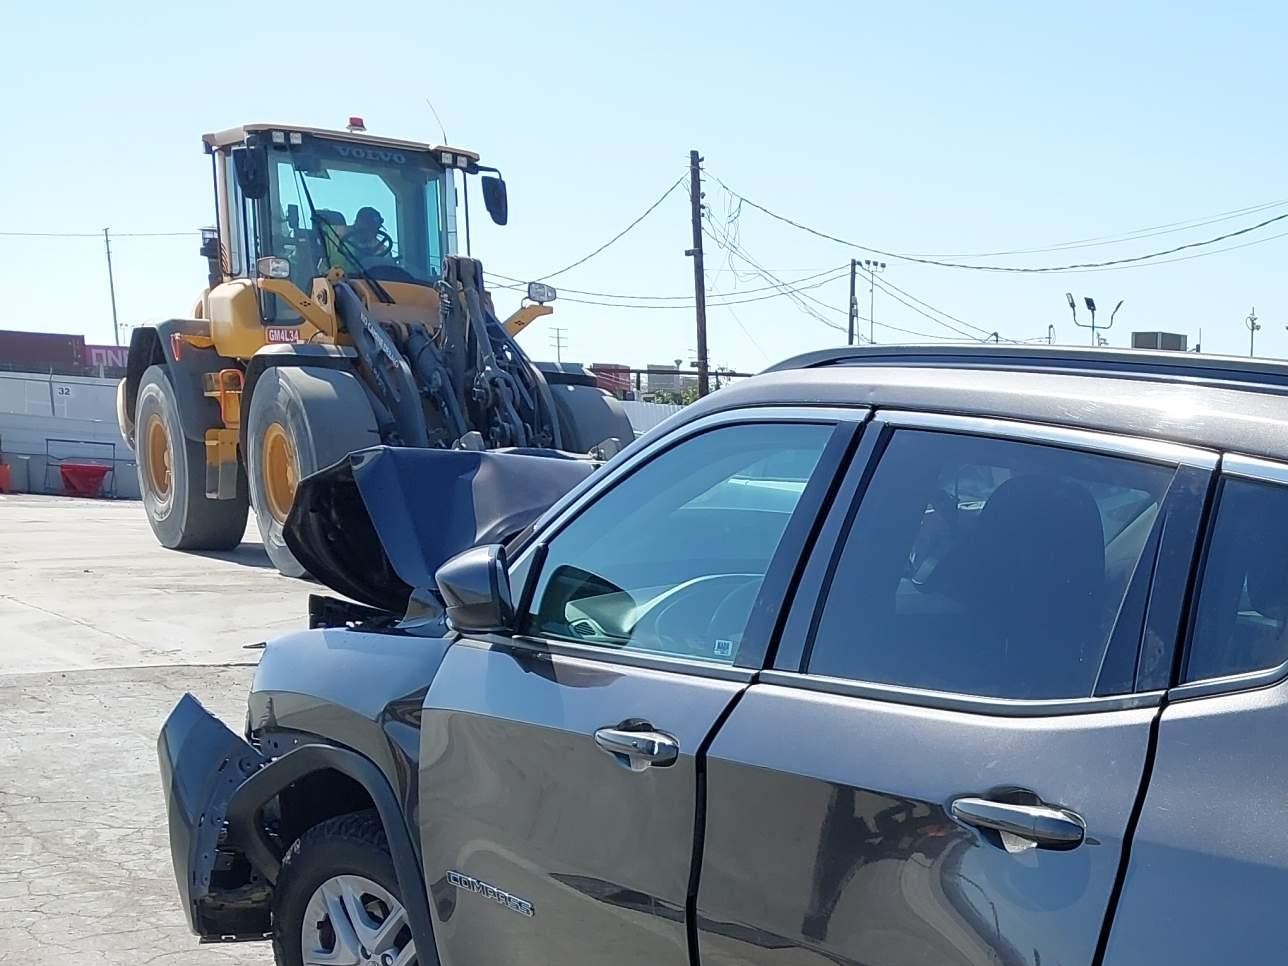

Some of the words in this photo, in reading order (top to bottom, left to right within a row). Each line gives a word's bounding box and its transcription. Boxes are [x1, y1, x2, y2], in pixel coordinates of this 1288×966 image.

[336, 145, 406, 164] VOLVO
[58, 387, 71, 396] 32
[445, 870, 535, 918] COMPASS
